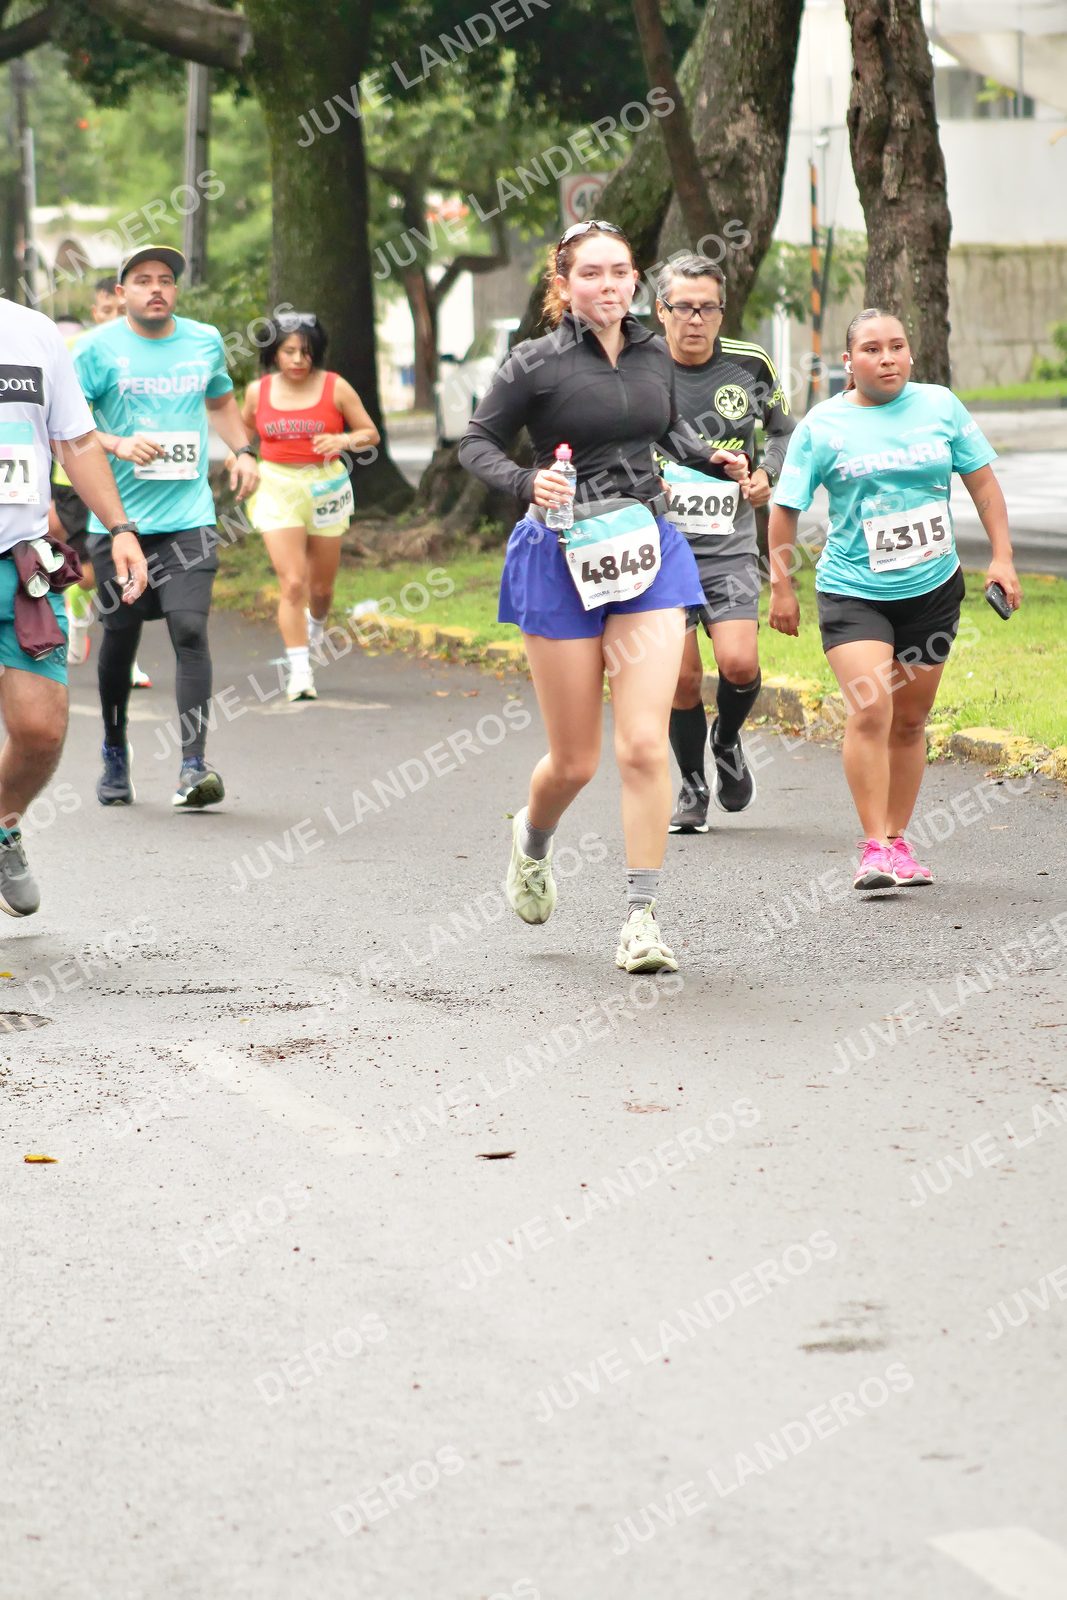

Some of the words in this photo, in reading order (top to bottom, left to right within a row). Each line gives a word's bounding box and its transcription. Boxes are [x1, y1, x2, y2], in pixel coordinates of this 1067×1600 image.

[669, 495, 734, 516] 4208
[876, 516, 945, 552] 4315
[582, 544, 656, 584] 4848
